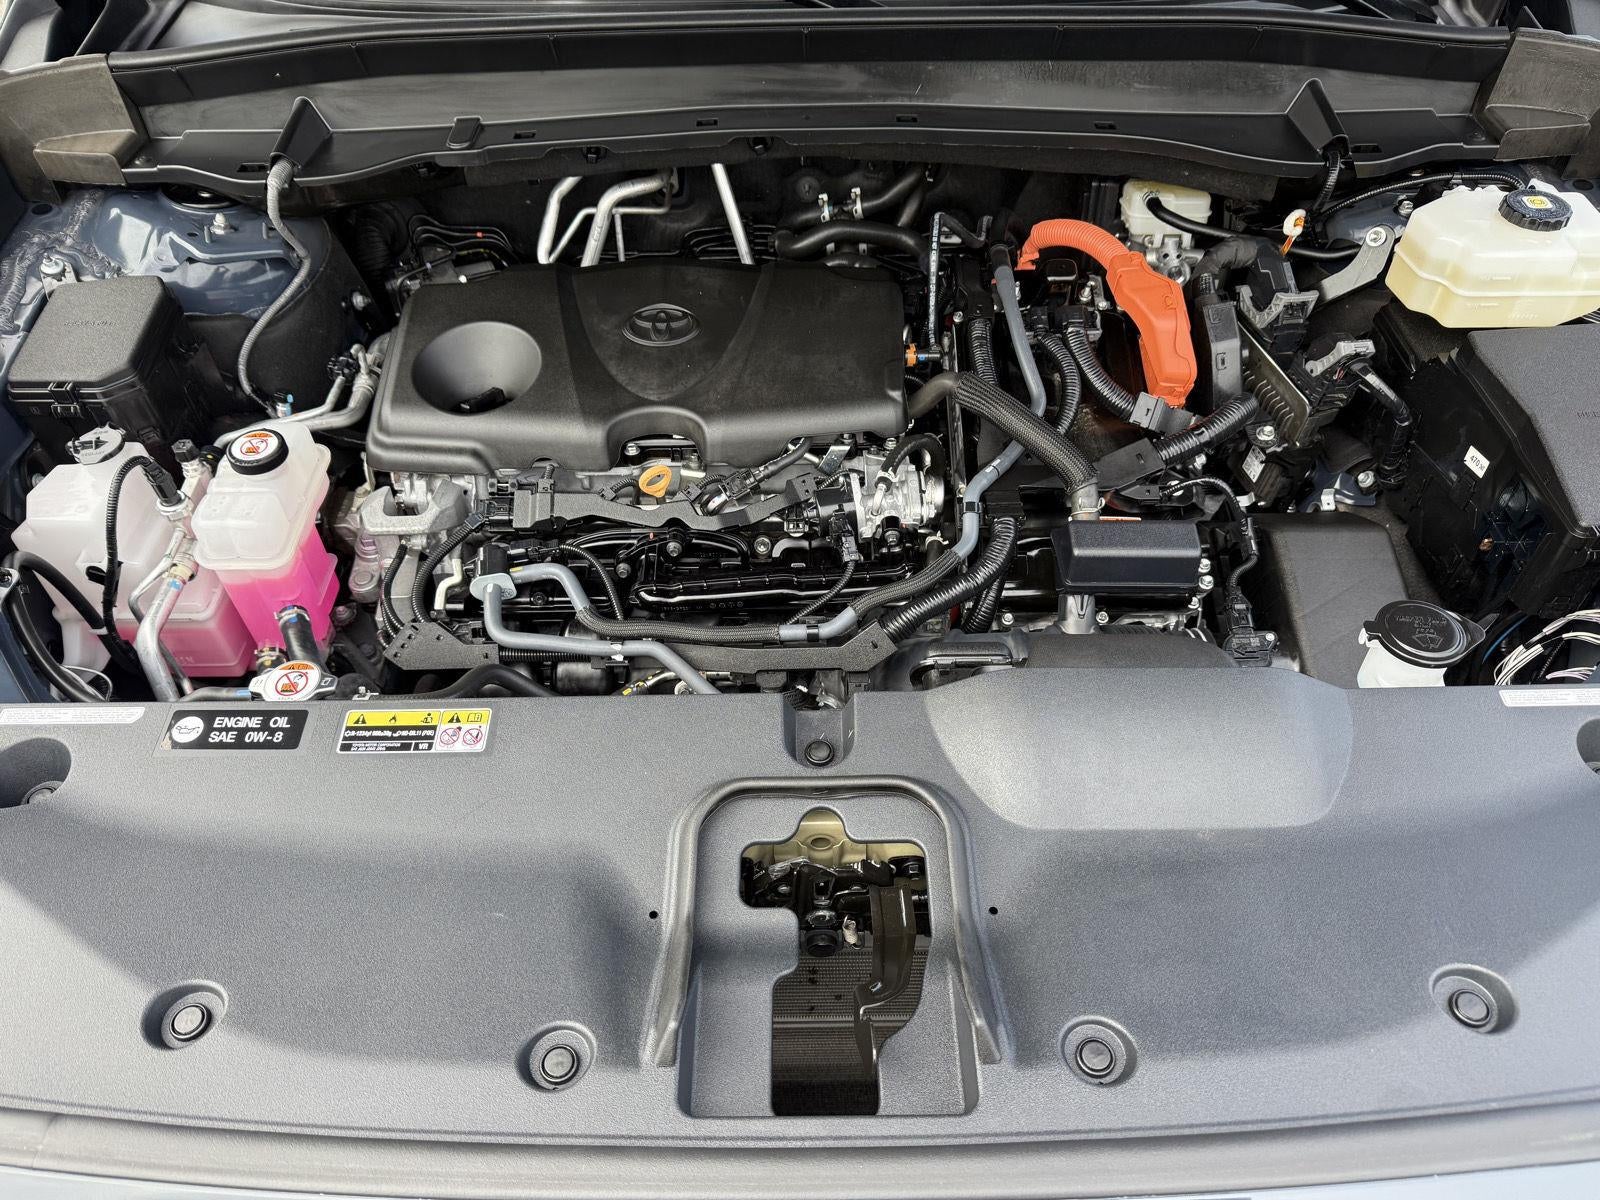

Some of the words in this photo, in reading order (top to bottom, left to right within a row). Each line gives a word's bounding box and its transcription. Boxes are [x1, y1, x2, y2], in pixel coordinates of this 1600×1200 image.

[213, 717, 263, 728] ENGINE
[269, 717, 291, 728] OIL
[208, 731, 237, 743] SAE
[244, 731, 284, 743] 0W-8
